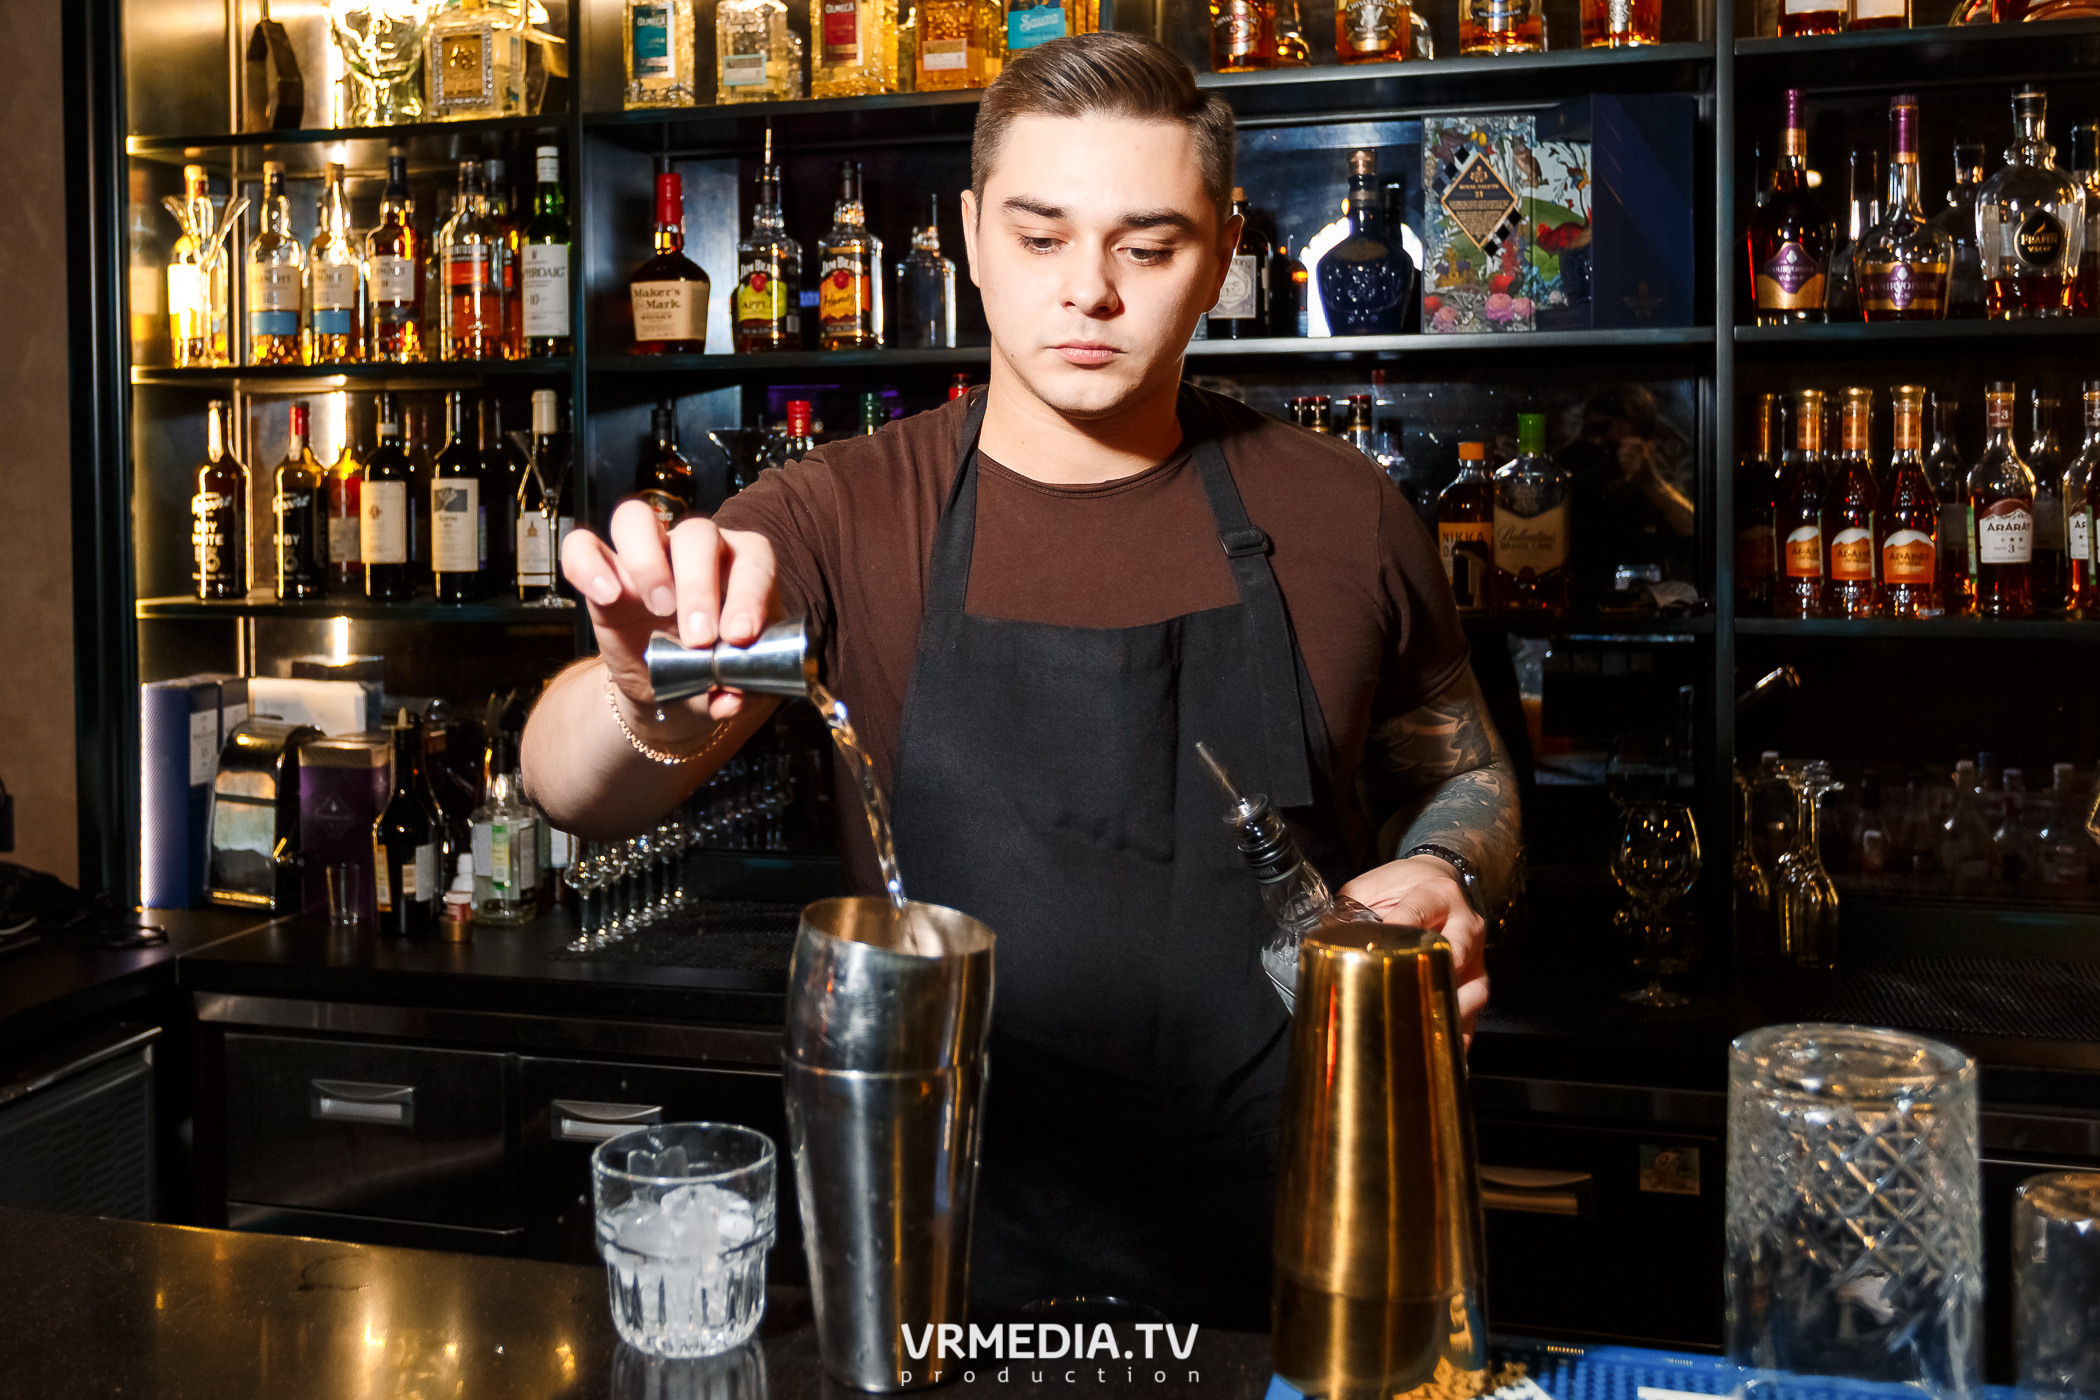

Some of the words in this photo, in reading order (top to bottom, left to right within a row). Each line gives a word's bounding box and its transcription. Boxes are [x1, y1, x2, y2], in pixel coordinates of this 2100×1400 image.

[739, 262, 754, 280] JIM
[821, 260, 837, 278] JIM
[633, 287, 681, 298] Maker's
[1987, 521, 2032, 532] ARARAT
